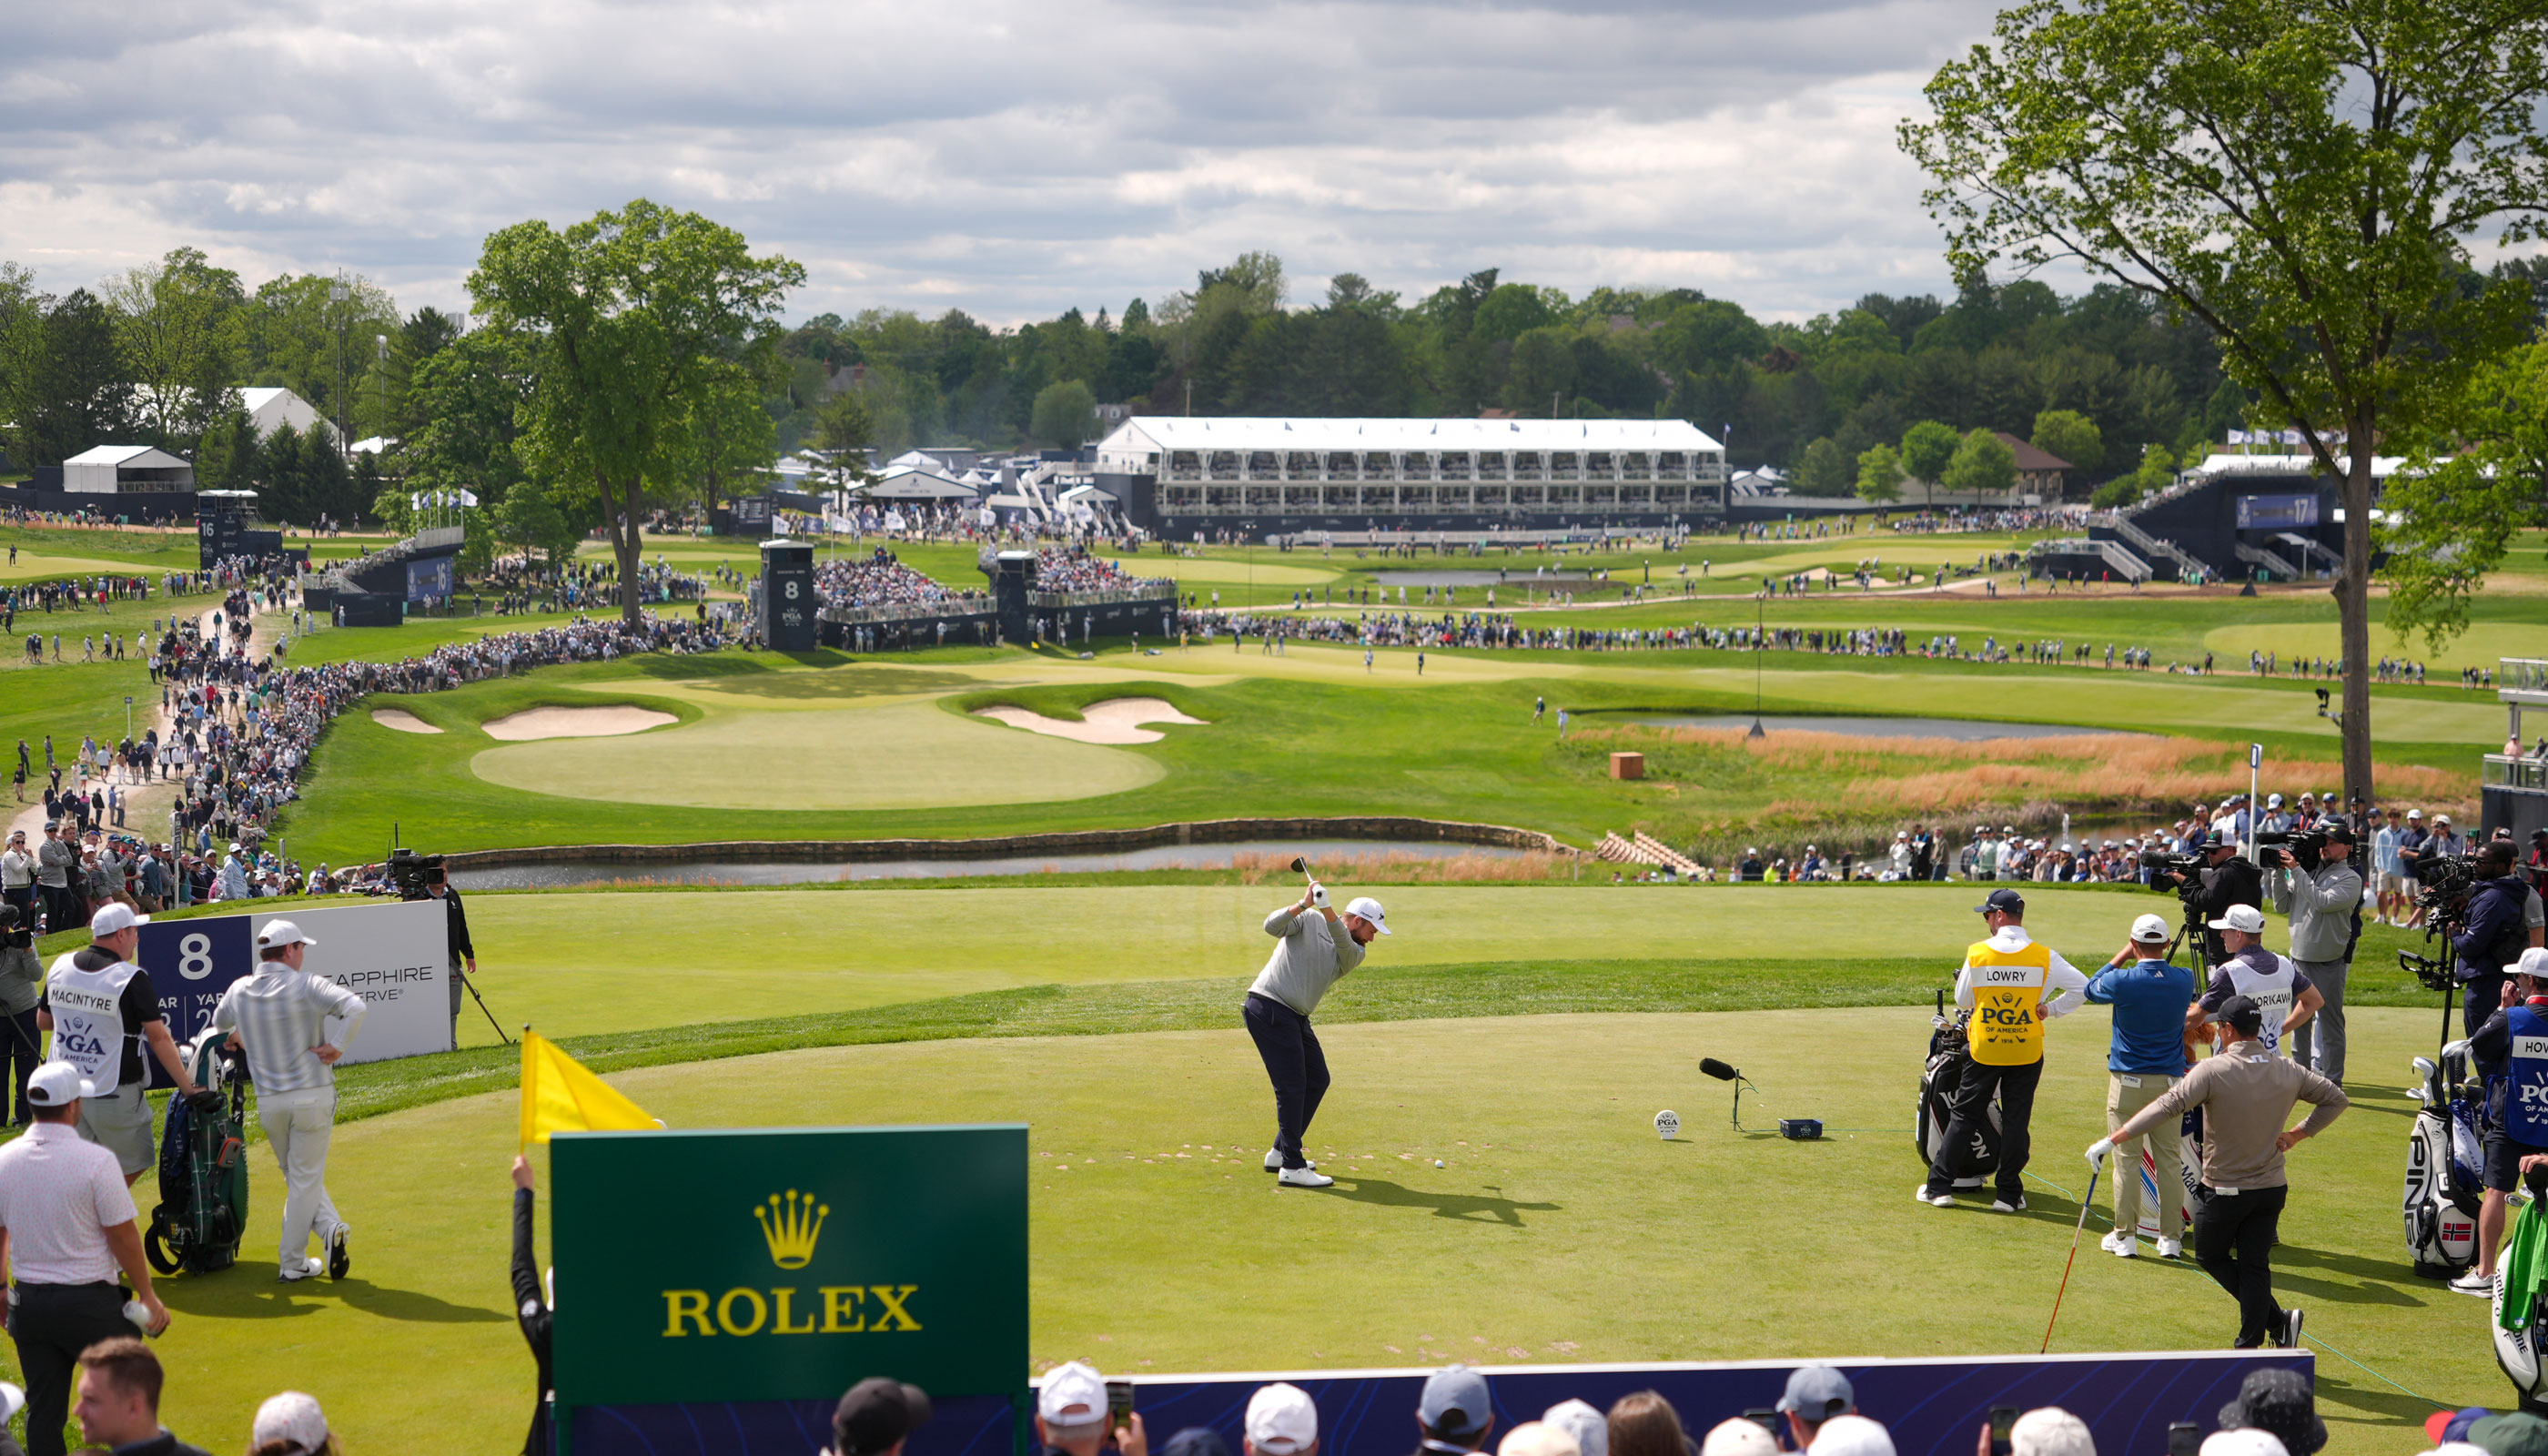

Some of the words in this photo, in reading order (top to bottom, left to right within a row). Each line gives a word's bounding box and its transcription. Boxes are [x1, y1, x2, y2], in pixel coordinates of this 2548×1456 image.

[2295, 499, 2309, 523] 17
[201, 522, 214, 537] 16
[437, 562, 446, 592] 16
[784, 581, 799, 600] 8
[1026, 589, 1037, 606] 10
[179, 933, 213, 980] 8
[323, 966, 433, 987] APPHIRE
[1987, 971, 2027, 982] LOWRY
[51, 989, 112, 1011] MACINTYRE
[157, 996, 177, 1009] AR
[1981, 1008, 2033, 1026] PGA
[64, 1054, 98, 1064] AMERICA
[2404, 1136, 2425, 1246] PING
[662, 1284, 924, 1338] ROLEX
